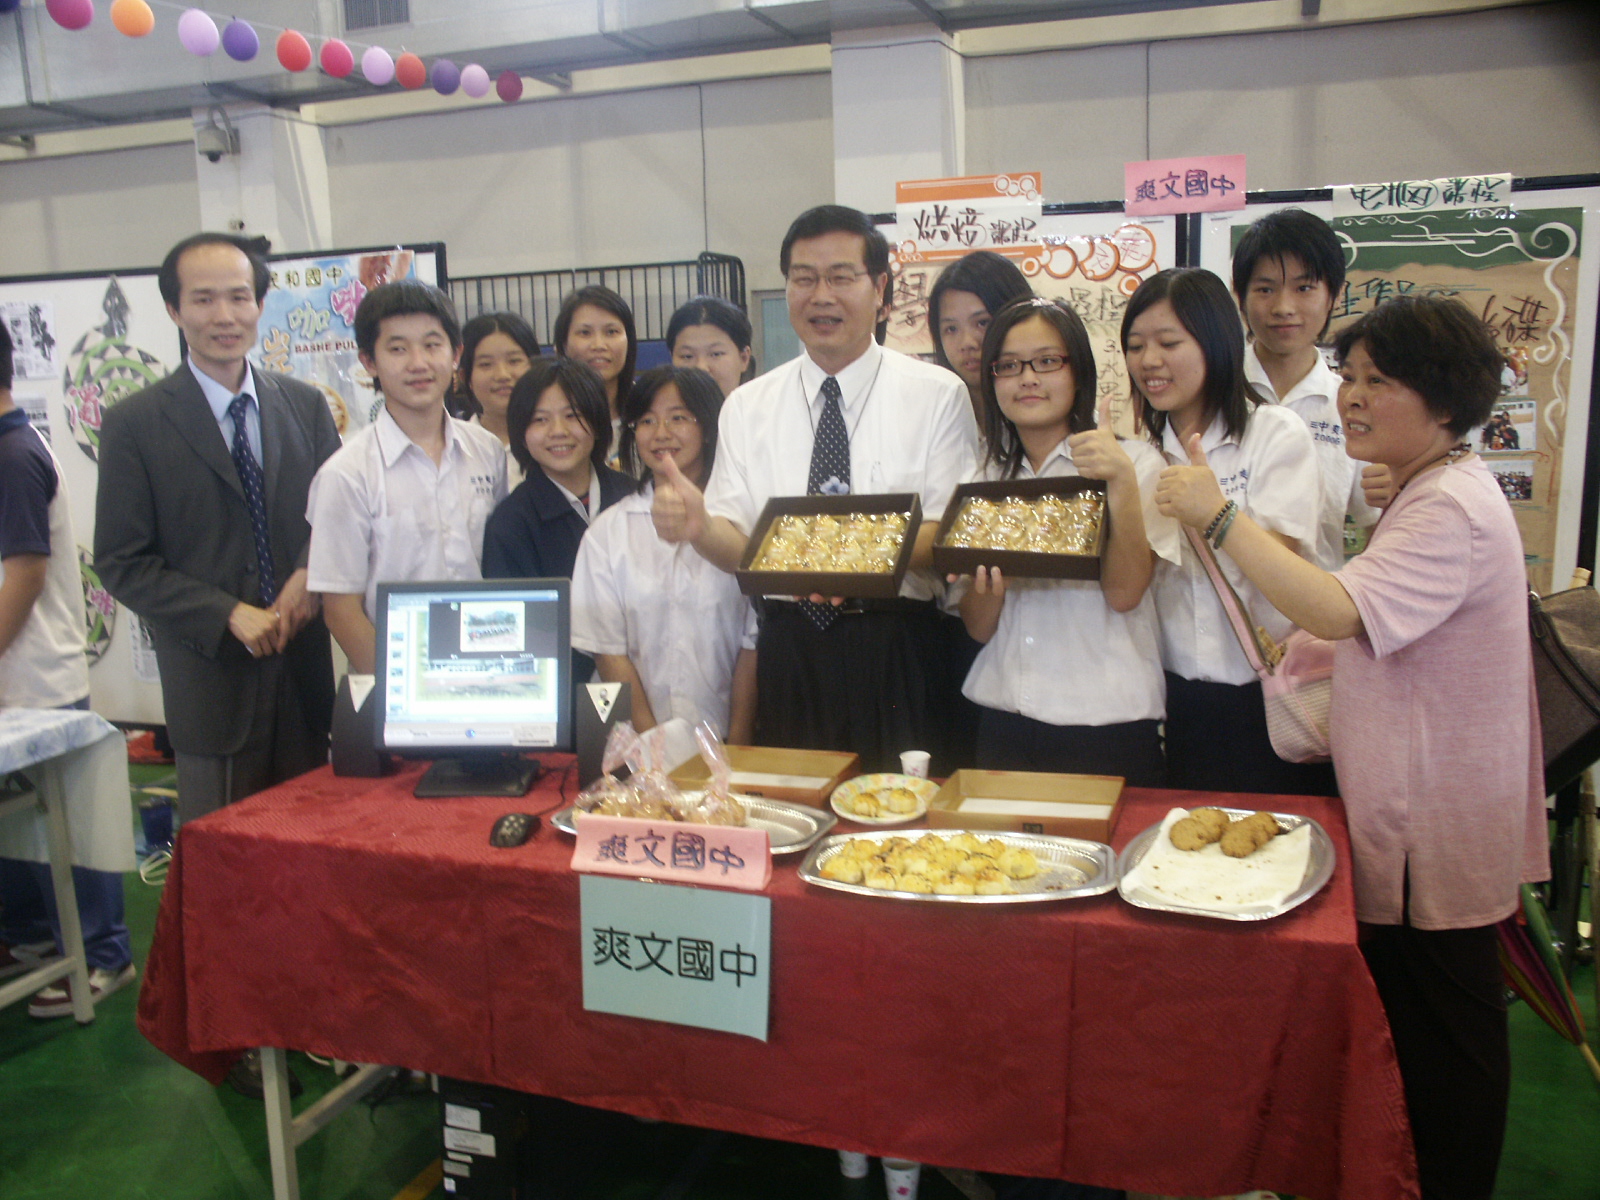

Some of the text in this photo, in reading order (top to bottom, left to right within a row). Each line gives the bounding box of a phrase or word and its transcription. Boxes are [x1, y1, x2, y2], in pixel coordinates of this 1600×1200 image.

[1134, 168, 1236, 202] 爽文國中
[594, 829, 745, 875] 爽文國中
[592, 926, 757, 988] 爽文國中
